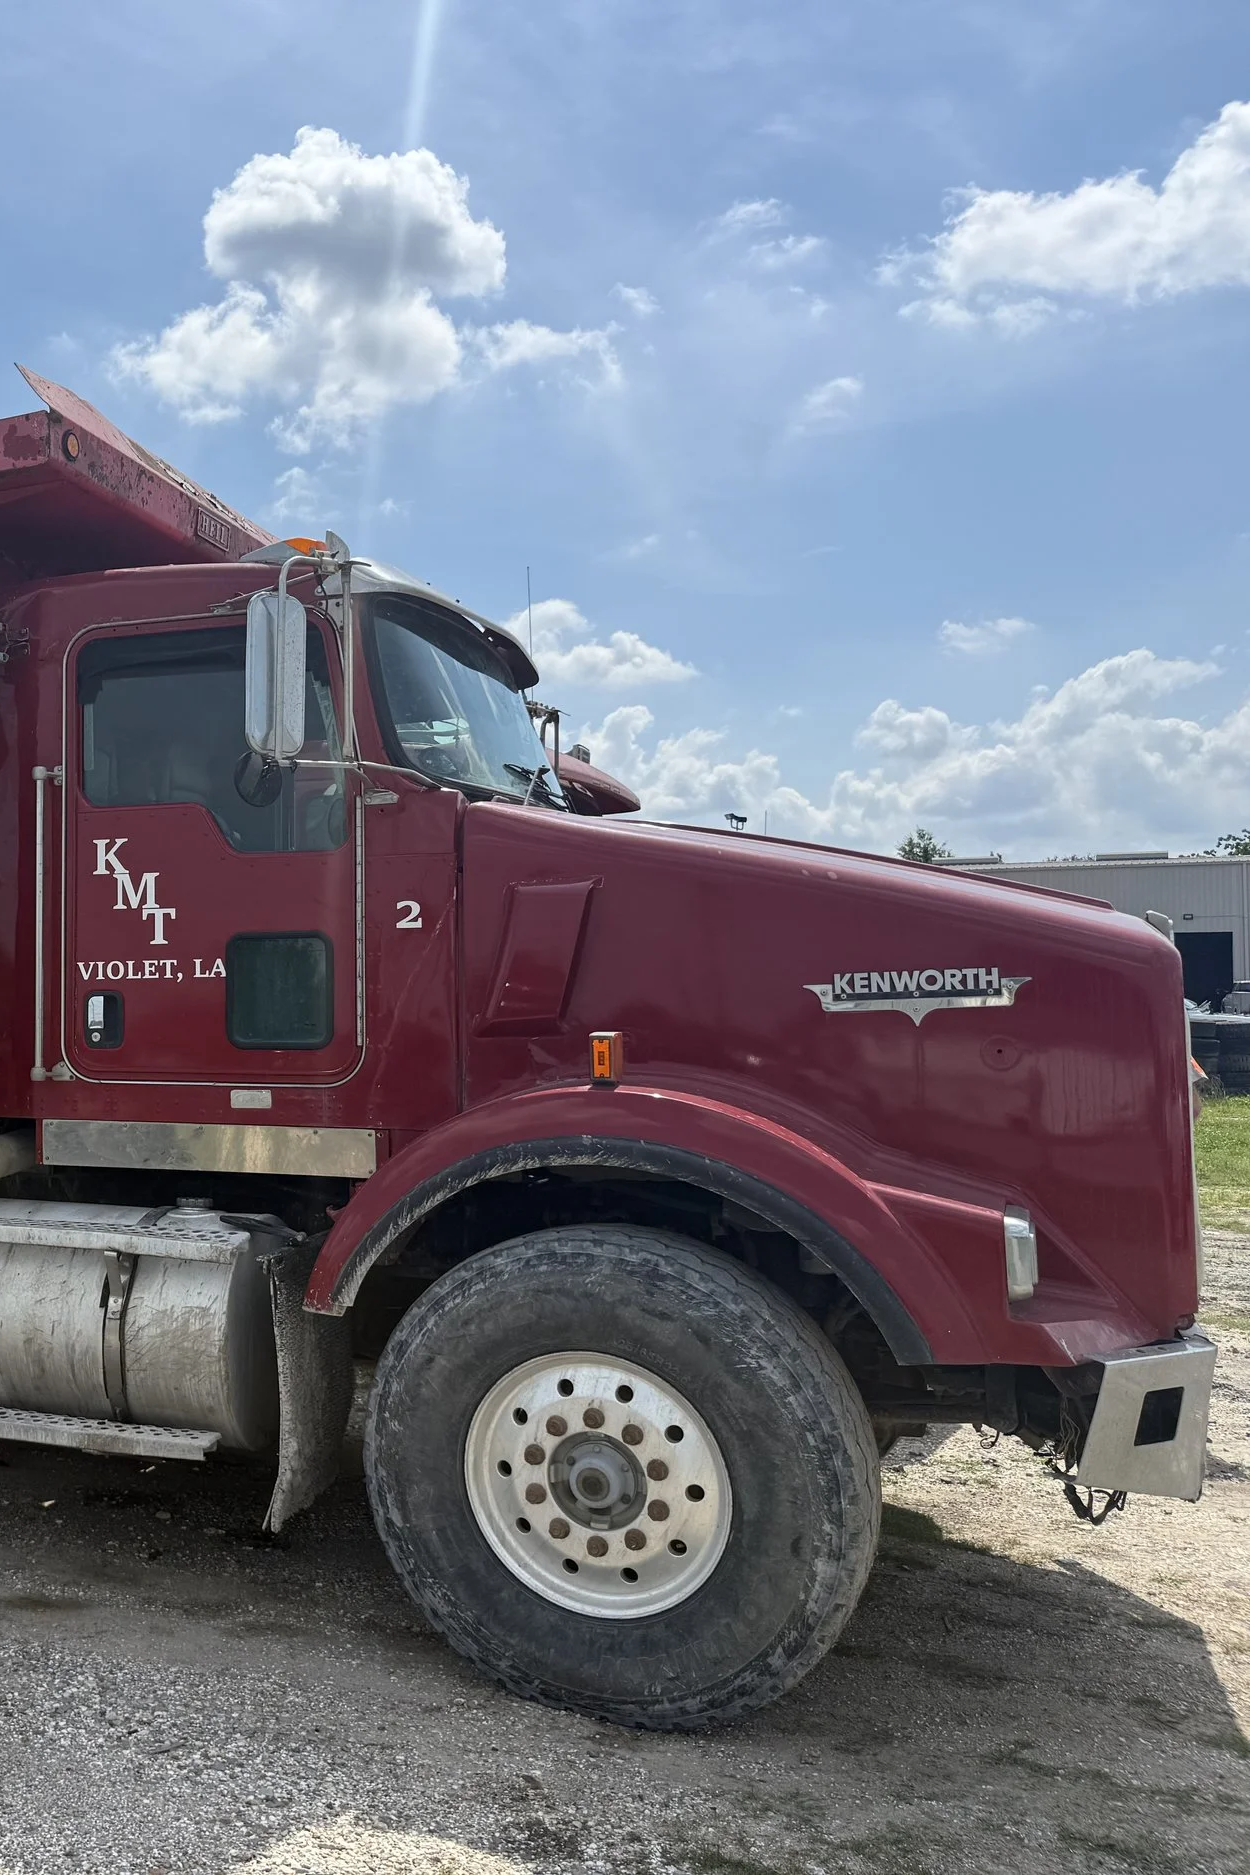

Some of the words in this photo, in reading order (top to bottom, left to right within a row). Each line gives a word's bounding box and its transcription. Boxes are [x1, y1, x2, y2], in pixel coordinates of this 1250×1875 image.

[201, 513, 227, 546] HEIL
[396, 900, 423, 929] 2
[77, 959, 184, 983] VIOLET,
[193, 958, 227, 978] LA
[833, 967, 999, 994] KENWORTH
